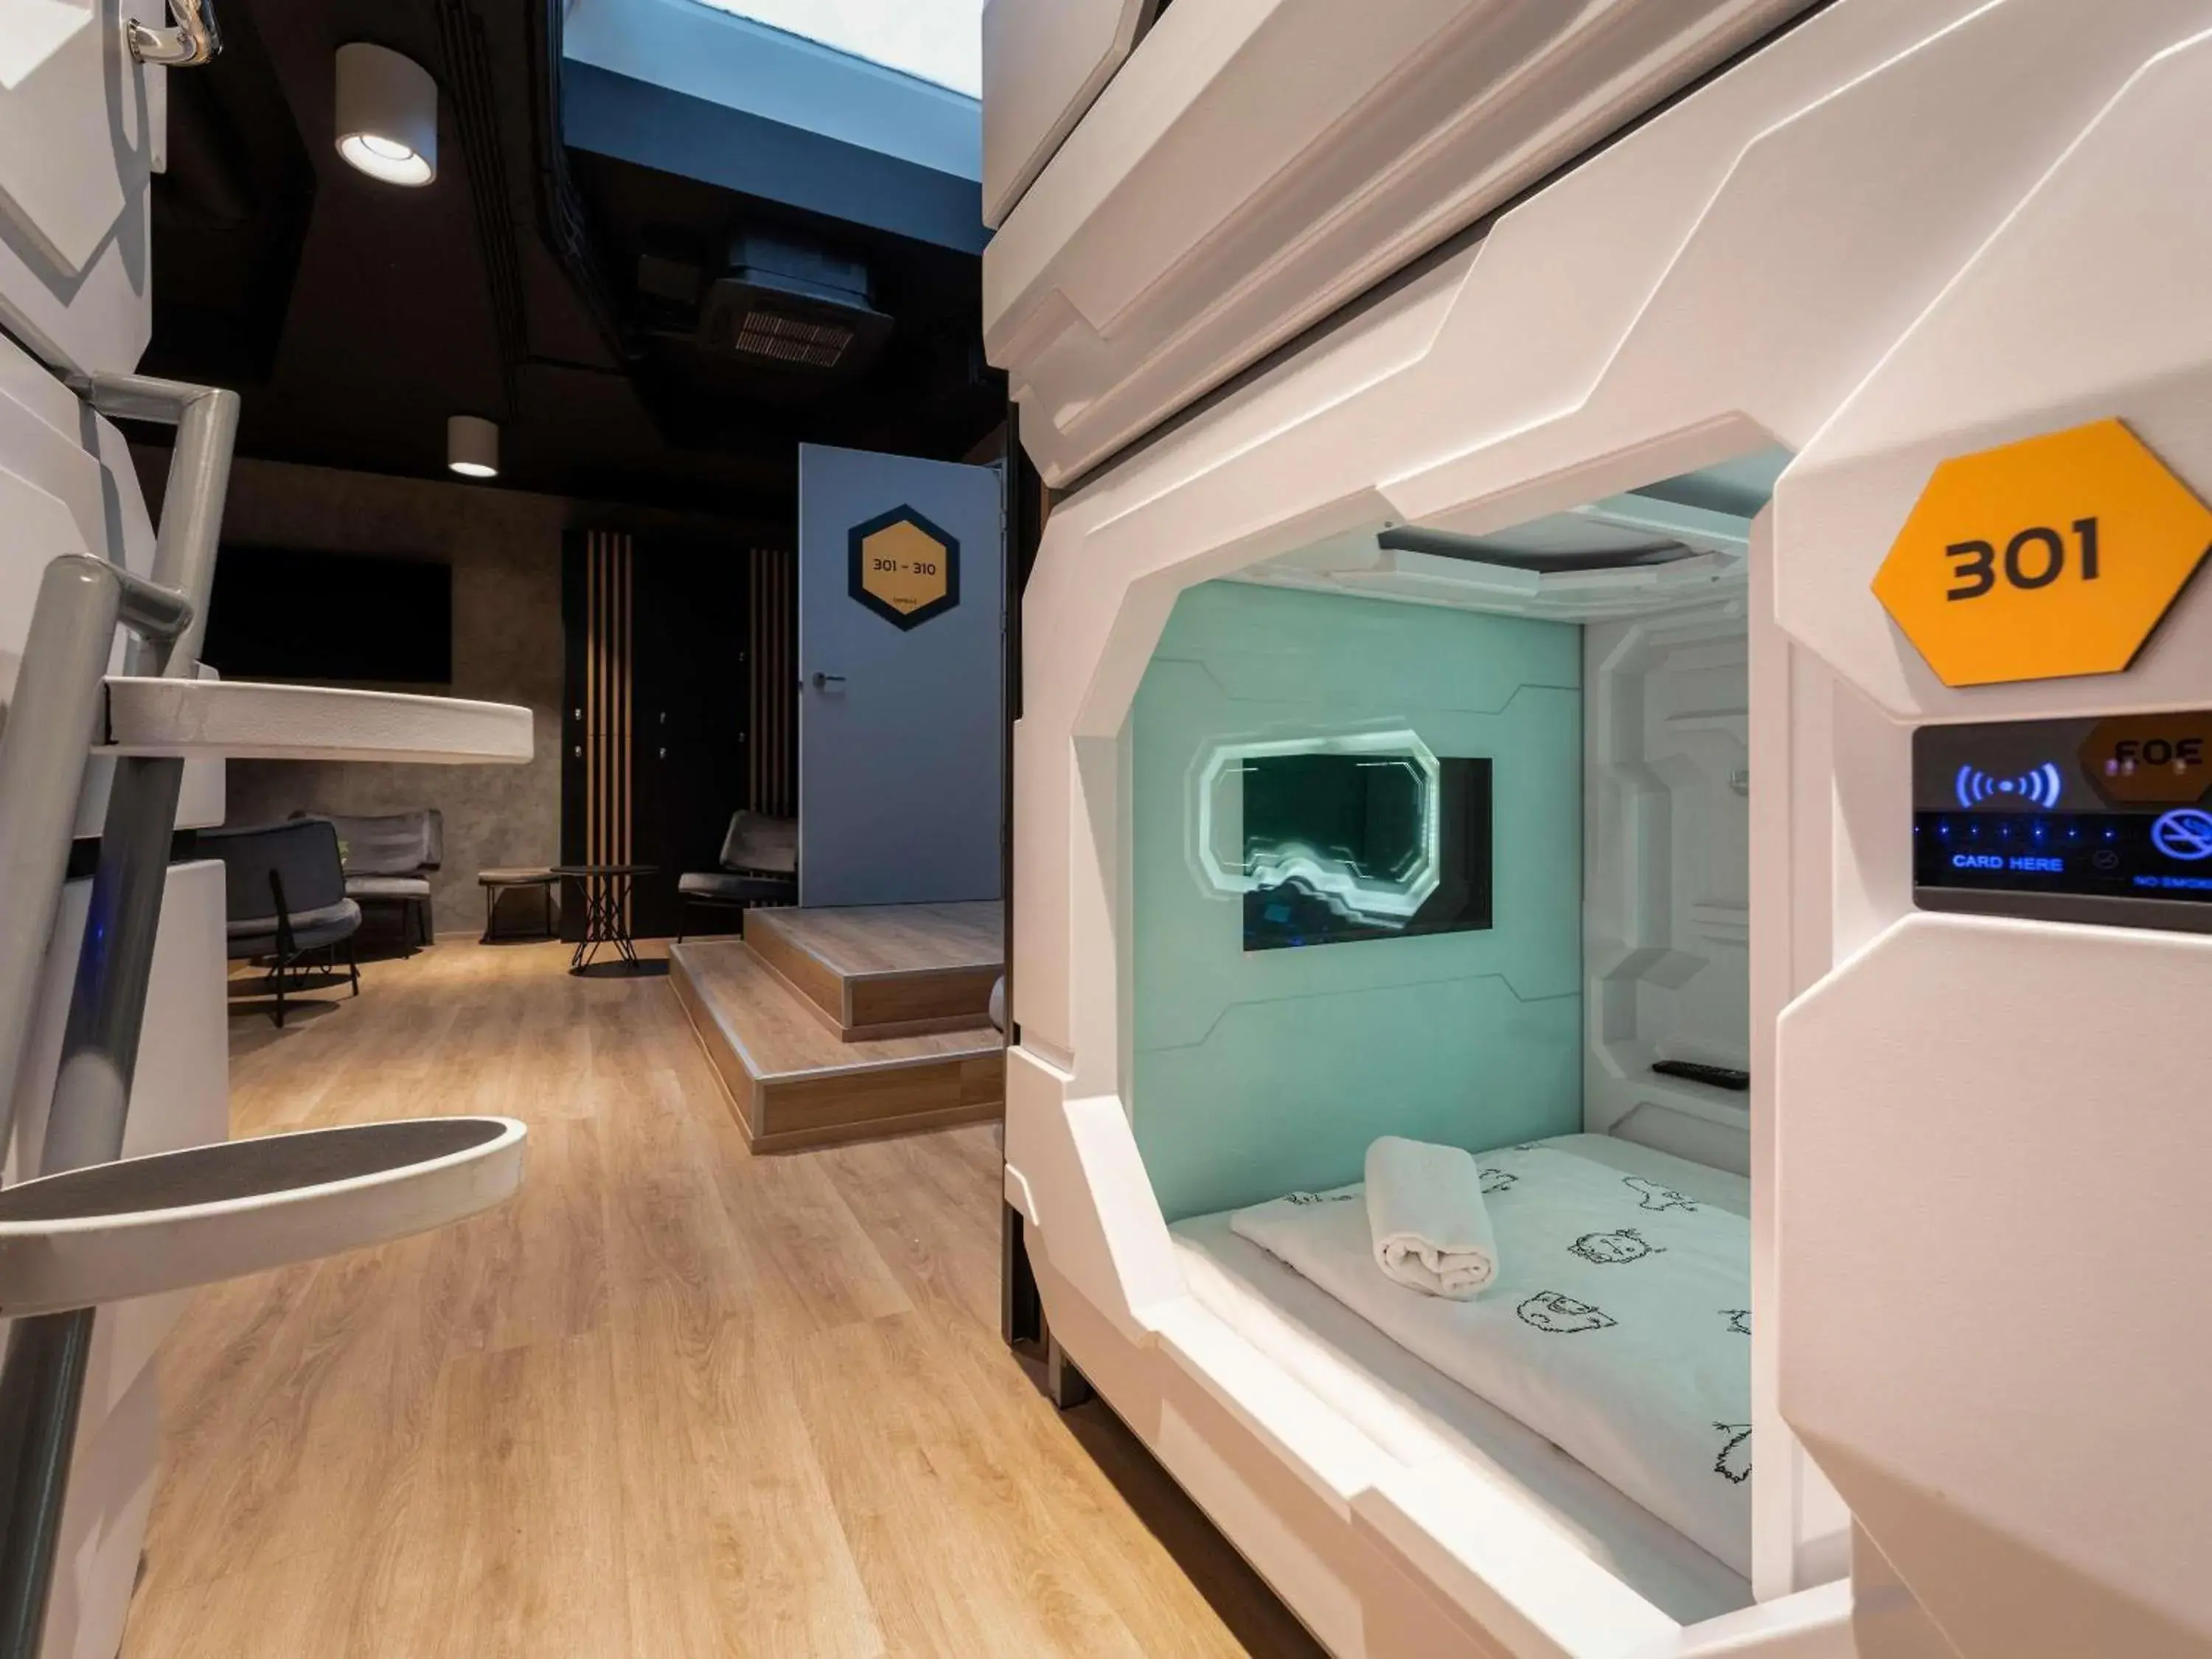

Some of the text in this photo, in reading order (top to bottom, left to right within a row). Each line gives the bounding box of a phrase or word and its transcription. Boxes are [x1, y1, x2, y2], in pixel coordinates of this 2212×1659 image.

[873, 558, 897, 572] 301
[913, 562, 936, 576] 310
[1945, 516, 2099, 602] 301
[1952, 855, 2065, 872] CARD HERE
